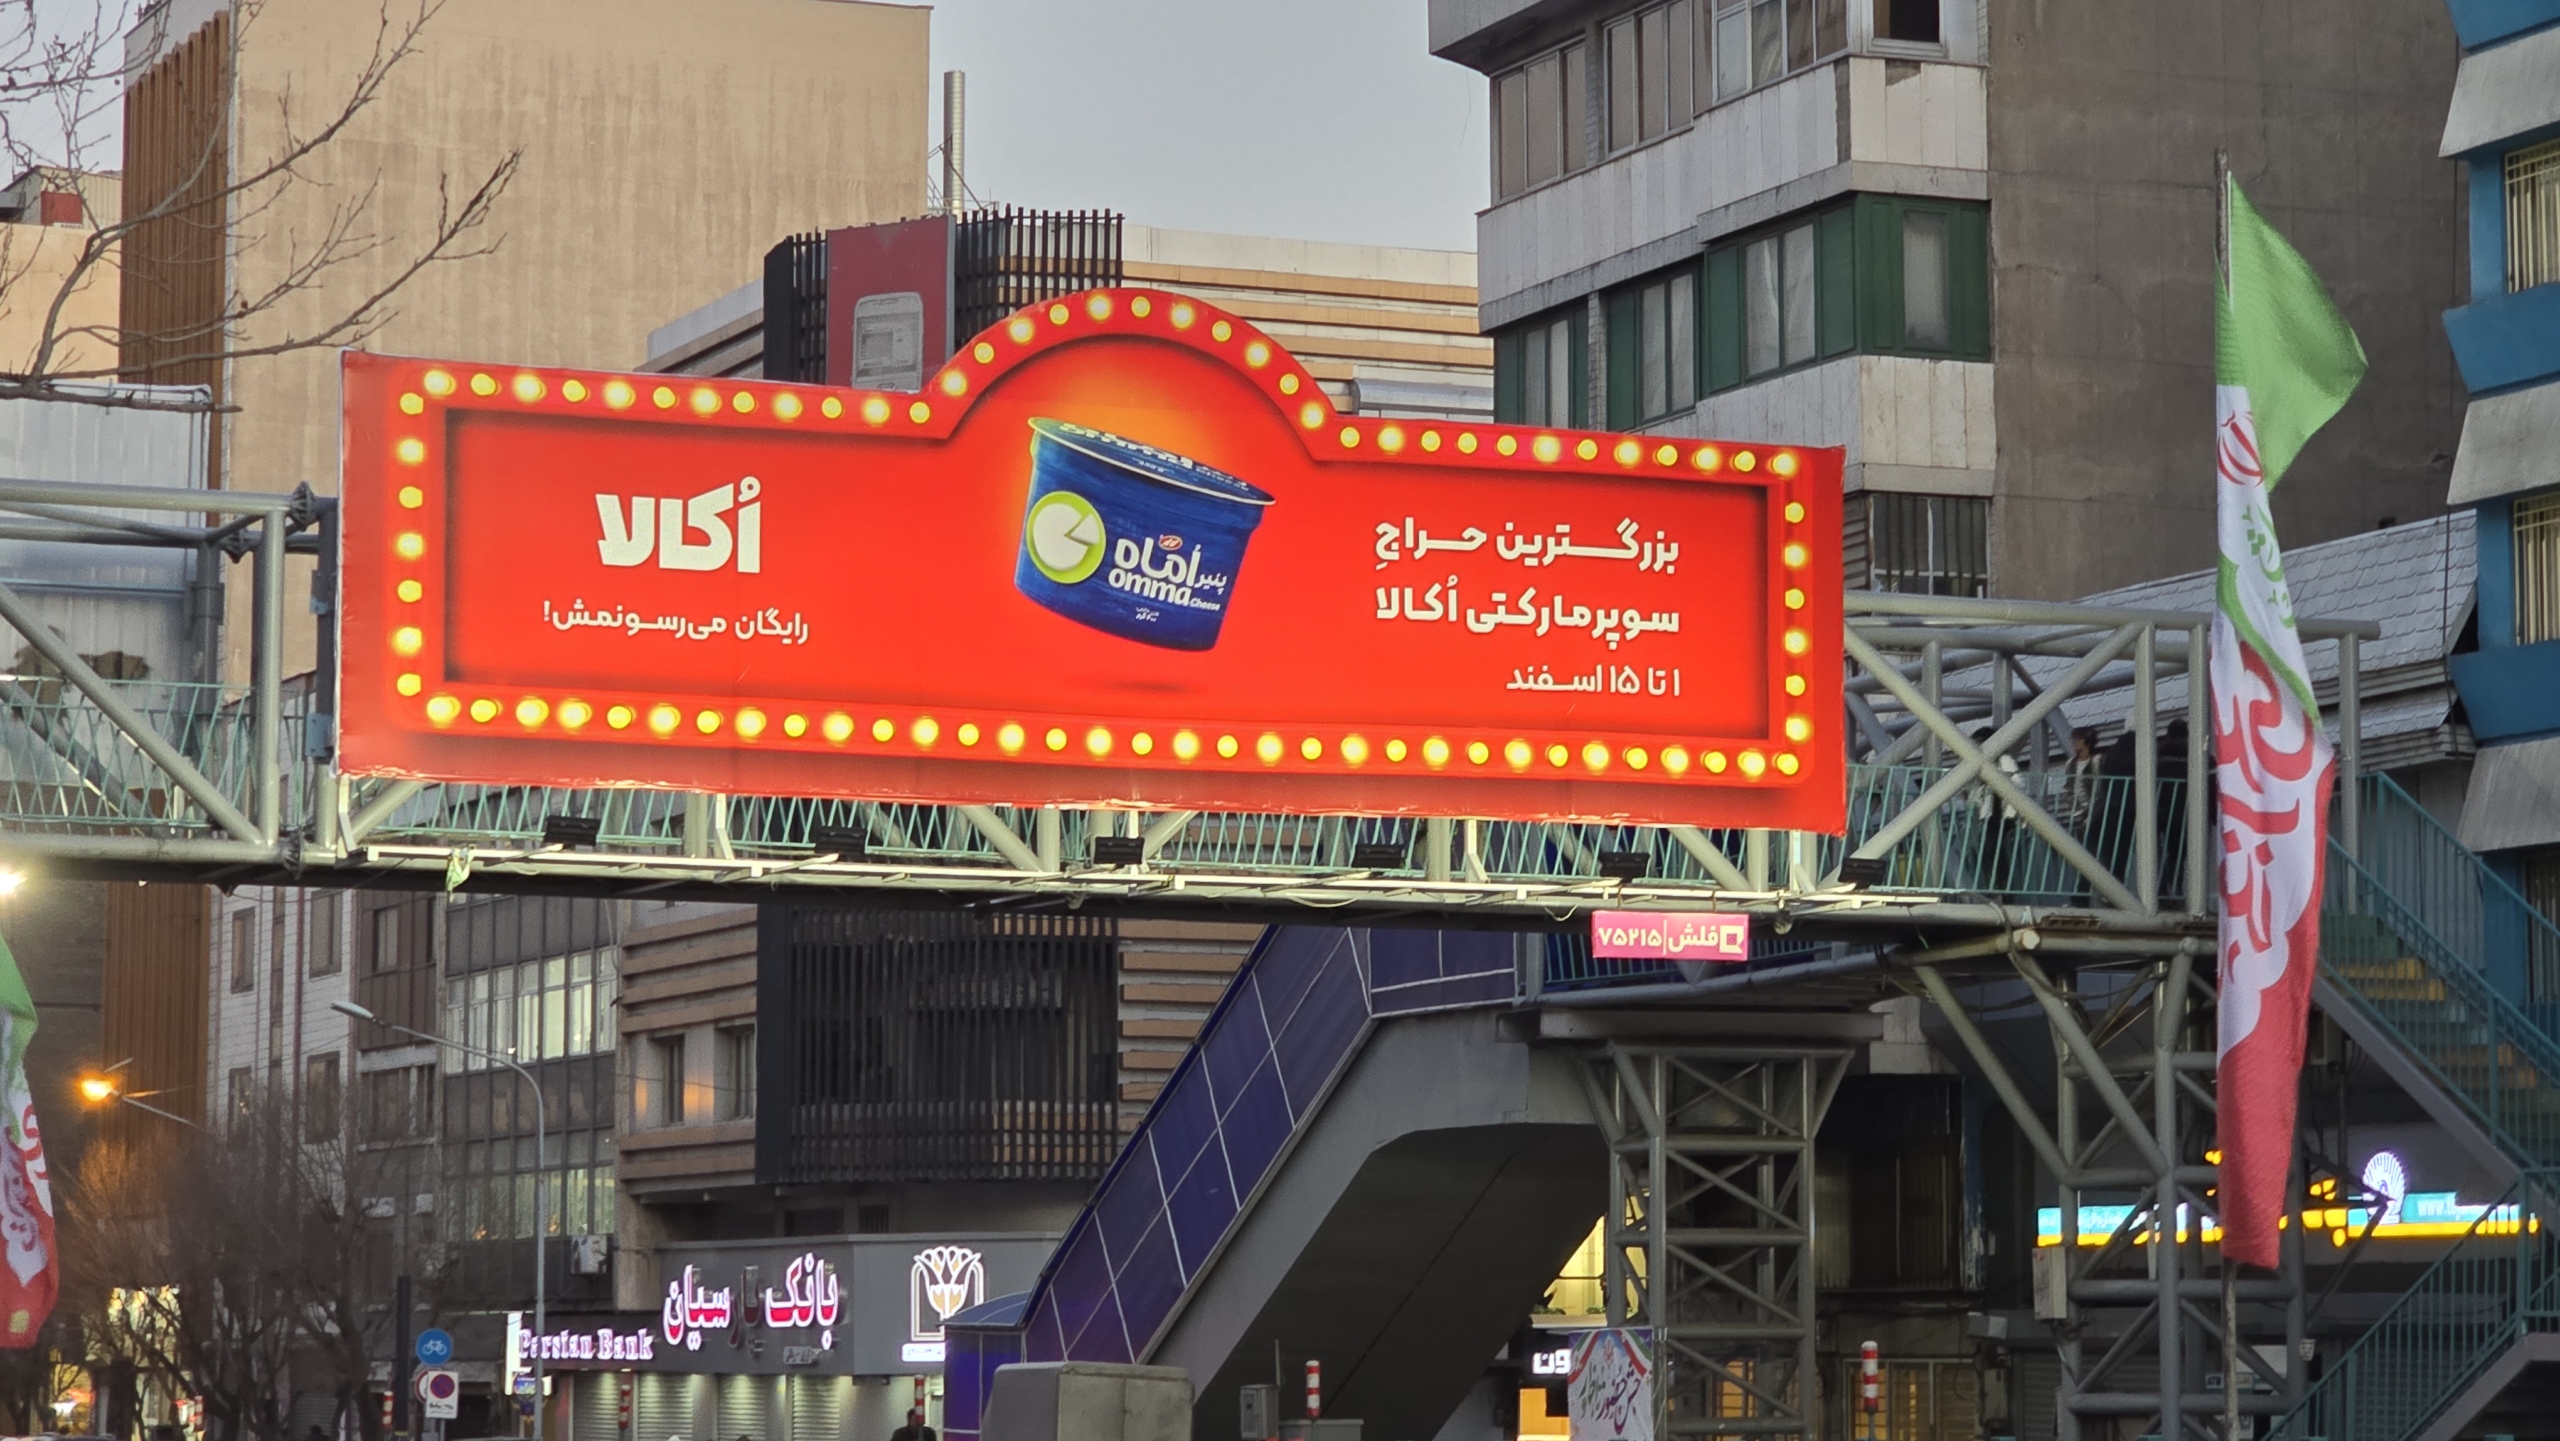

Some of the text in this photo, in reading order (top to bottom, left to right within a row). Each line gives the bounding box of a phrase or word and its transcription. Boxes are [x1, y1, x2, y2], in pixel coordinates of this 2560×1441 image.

[1496, 517, 1679, 574] بزرگترین
[1108, 567, 1192, 607] omma
[1194, 573, 1228, 595] پنیر
[735, 608, 809, 644] رایگان
[1466, 587, 1680, 651] سوپرمارکتی
[1506, 664, 1602, 693] اسفند
[1647, 667, 1666, 695] تا
[1668, 923, 1719, 953] فلش
[764, 1252, 839, 1351] بانک
[518, 1328, 654, 1360] Persian Bank
